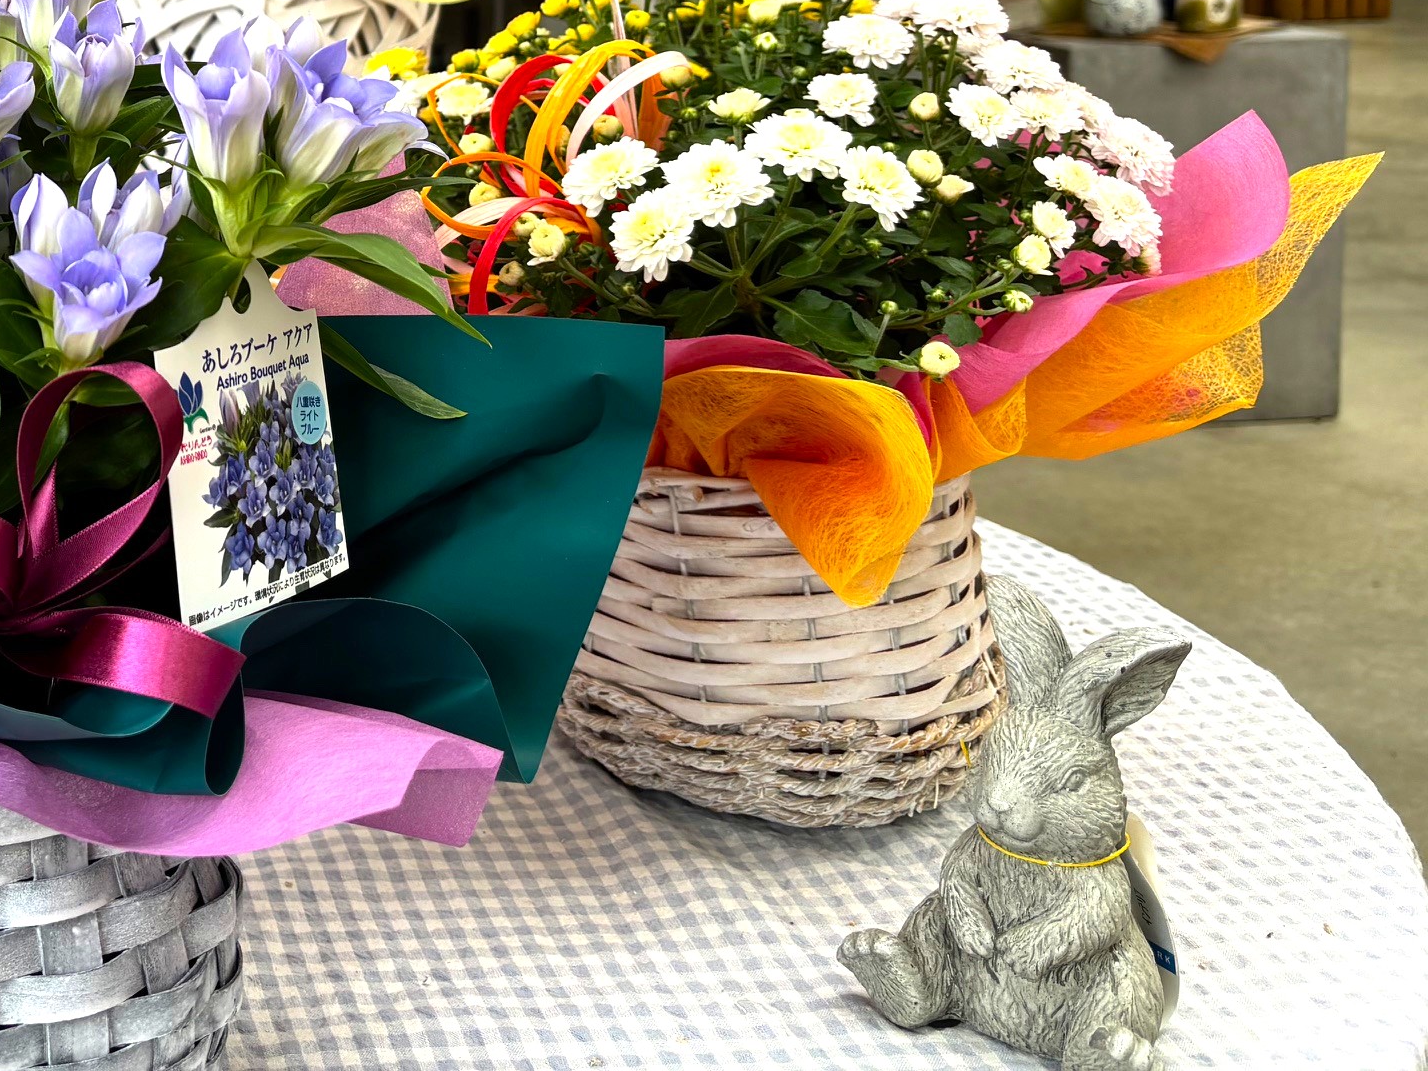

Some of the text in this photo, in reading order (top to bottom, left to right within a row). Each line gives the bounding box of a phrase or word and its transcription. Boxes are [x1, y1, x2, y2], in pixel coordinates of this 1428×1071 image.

[202, 322, 313, 373] あしろブーケ アクア
[217, 353, 310, 391] Ashiro Bouquet Aqua
[296, 396, 321, 408] 八重咲き
[300, 410, 319, 422] ライト
[300, 424, 320, 436] ブルー
